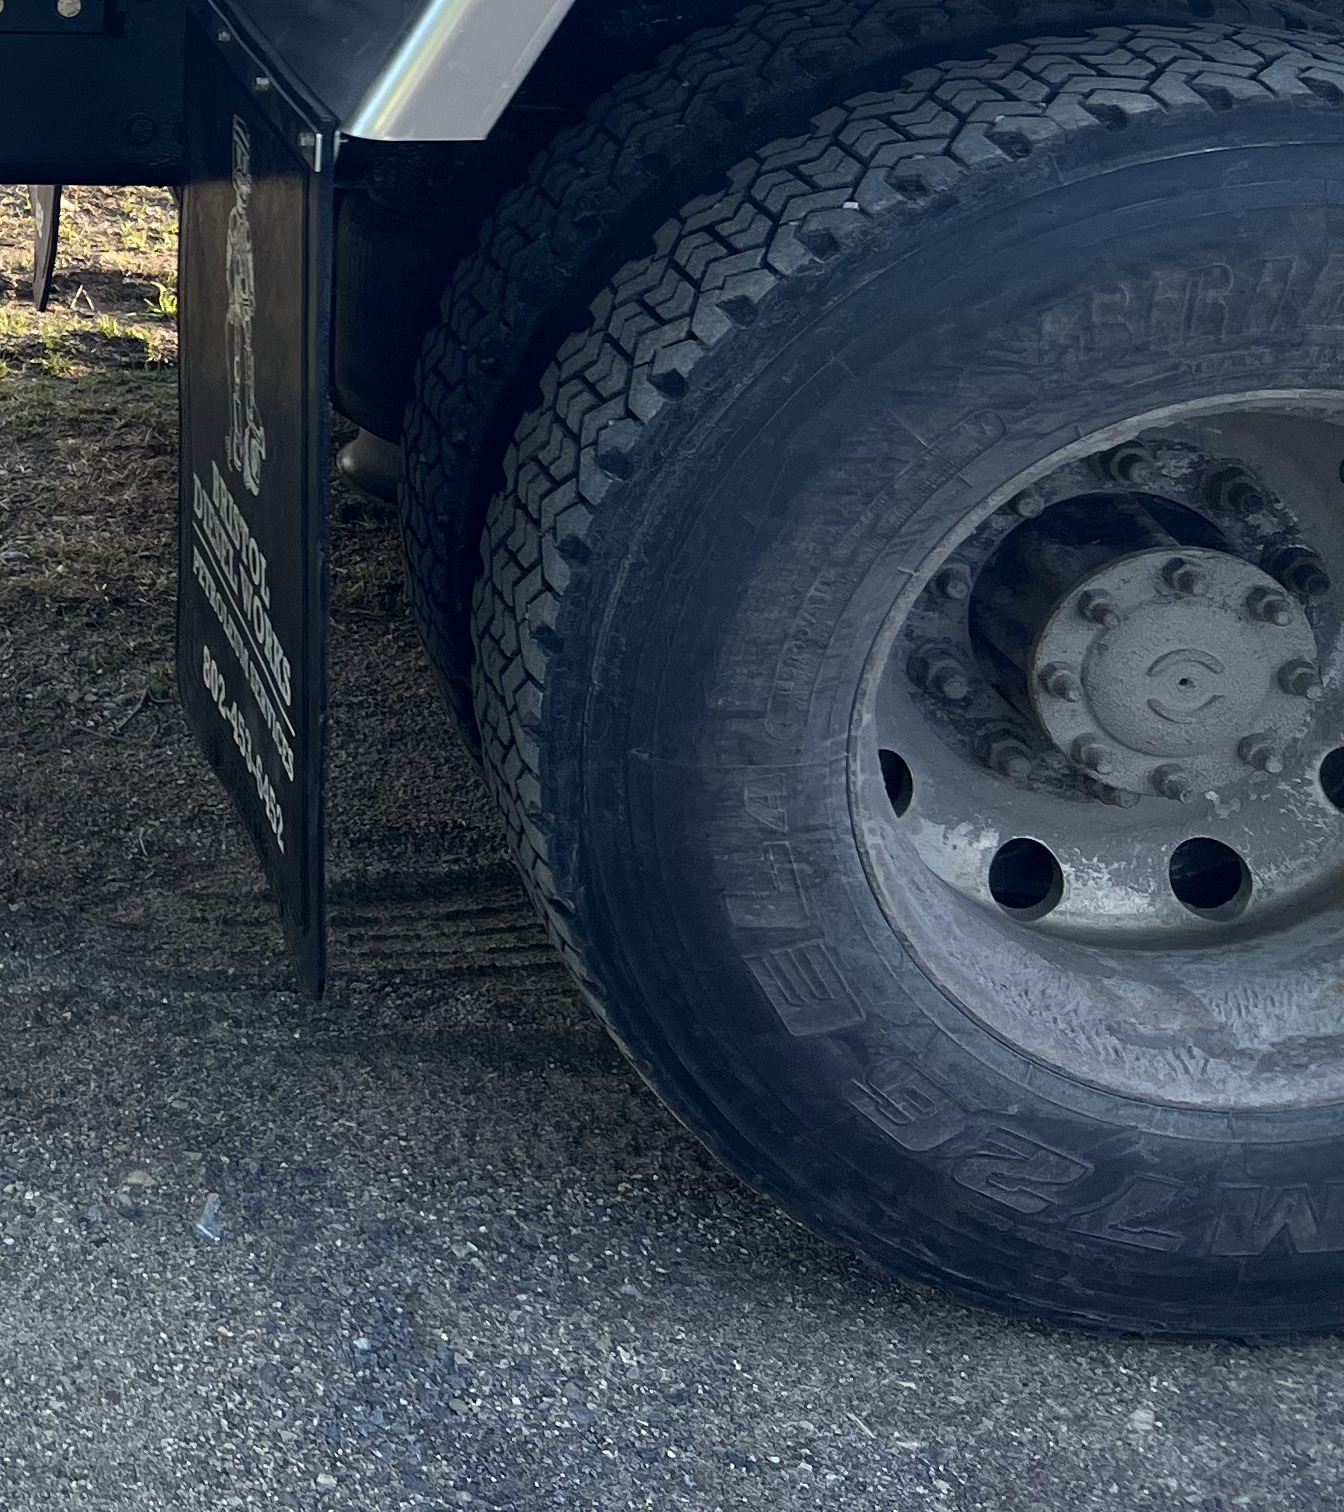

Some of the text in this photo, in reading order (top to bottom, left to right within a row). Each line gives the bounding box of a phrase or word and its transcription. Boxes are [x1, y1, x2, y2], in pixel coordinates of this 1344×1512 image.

[192, 471, 292, 708] DIESEL WORKS
[211, 459, 270, 610] BRISTOL
[192, 544, 294, 783] PETROLEUM SERVICES
